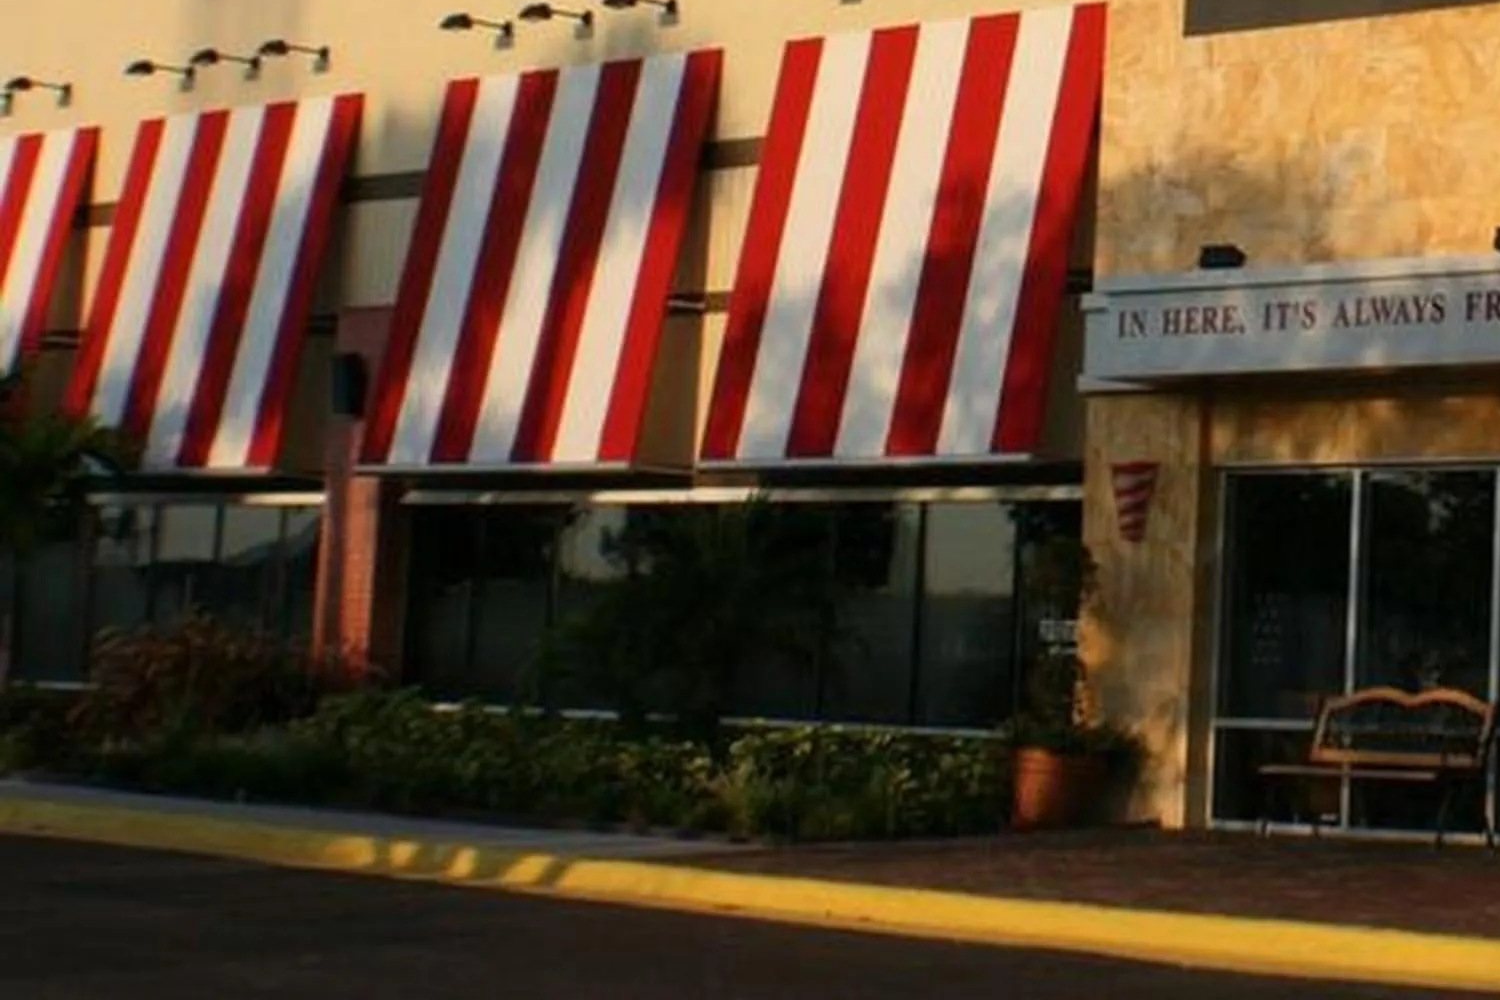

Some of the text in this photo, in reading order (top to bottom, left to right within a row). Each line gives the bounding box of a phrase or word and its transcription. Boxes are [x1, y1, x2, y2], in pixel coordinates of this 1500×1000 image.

[1117, 310, 1148, 339] IN
[1262, 301, 1318, 332] IT'S
[1332, 294, 1446, 328] ALWAYS
